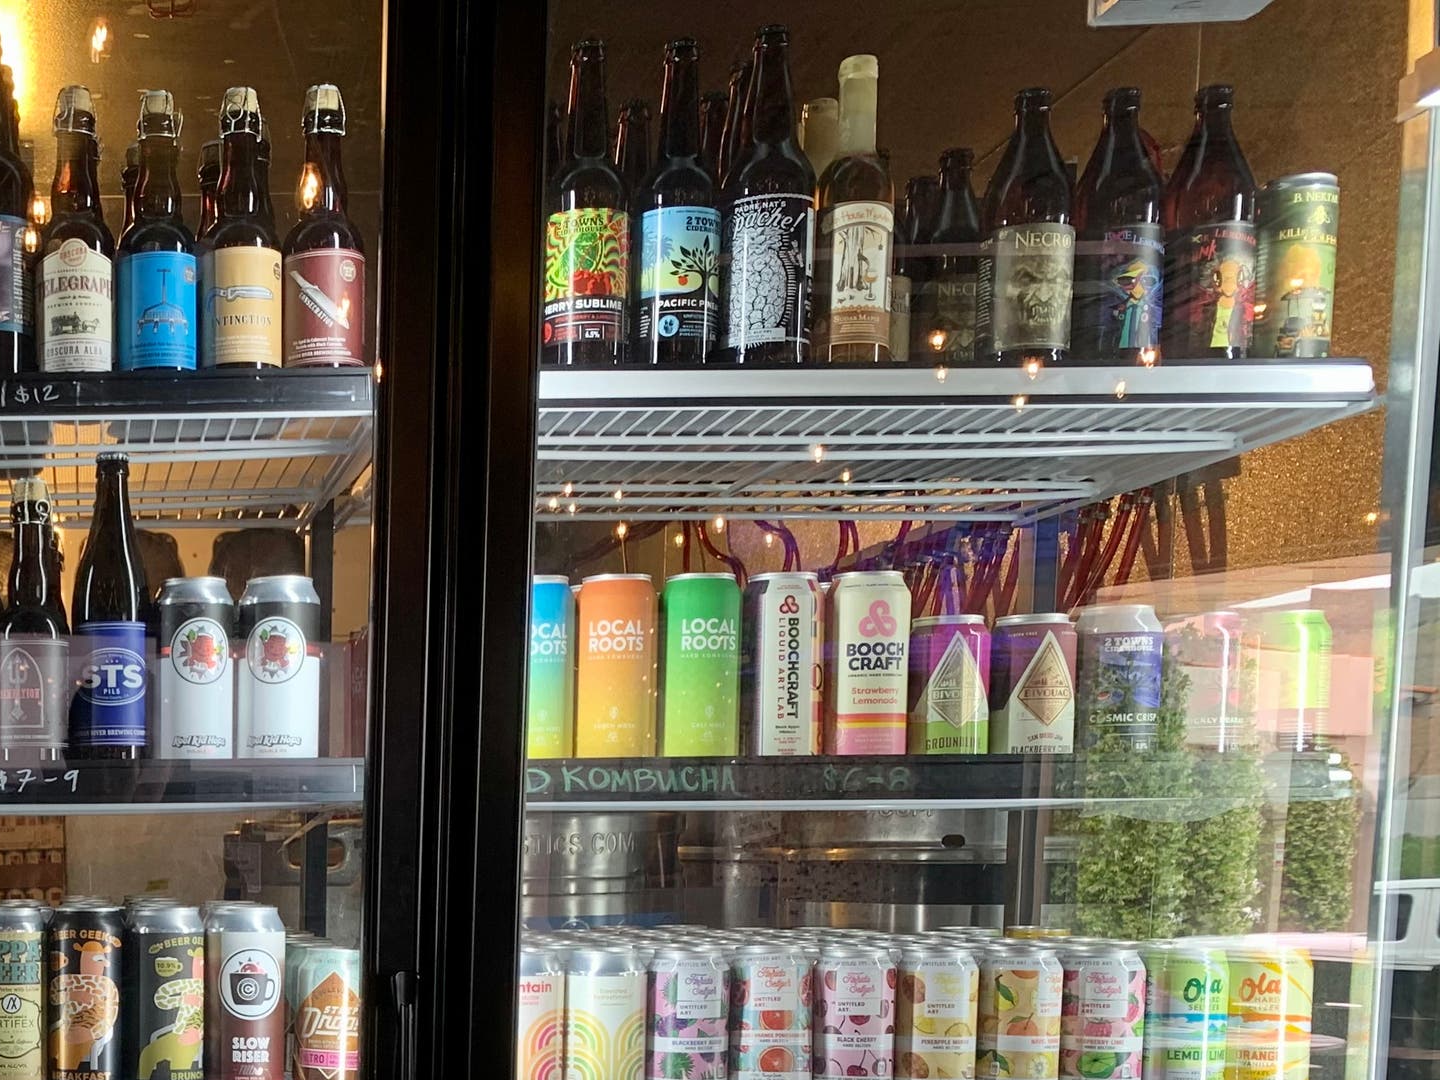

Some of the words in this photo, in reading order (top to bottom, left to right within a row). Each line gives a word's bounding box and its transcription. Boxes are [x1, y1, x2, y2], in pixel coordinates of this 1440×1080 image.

[762, 200, 787, 210] NAT'S
[545, 300, 573, 312] HERRY
[575, 299, 623, 312] SUBLIME
[657, 299, 698, 309] PACIFIC
[15, 384, 60, 402] $12
[589, 619, 644, 637] LOCAL
[681, 618, 736, 635] LOCAL
[588, 637, 645, 653] ROOTS
[681, 635, 736, 652] ROOTS
[778, 617, 786, 661] LIQUID
[1114, 636, 1155, 647] TOWNS
[846, 642, 904, 657] BOOCH
[787, 617, 800, 719] BOOCHCRAFT
[848, 657, 902, 671] CRAFT
[81, 665, 143, 688] STS
[777, 668, 785, 690] ART
[777, 697, 785, 720] LAB
[562, 764, 737, 794] KOMBUCHA
[164, 937, 191, 949] BEER
[1182, 976, 1224, 1004] Ola
[1238, 972, 1283, 1001] Ola
[231, 1037, 271, 1051] SLOW
[835, 1036, 856, 1044] BLACK
[857, 1036, 878, 1045] CHERRY
[231, 1049, 271, 1063] RISER
